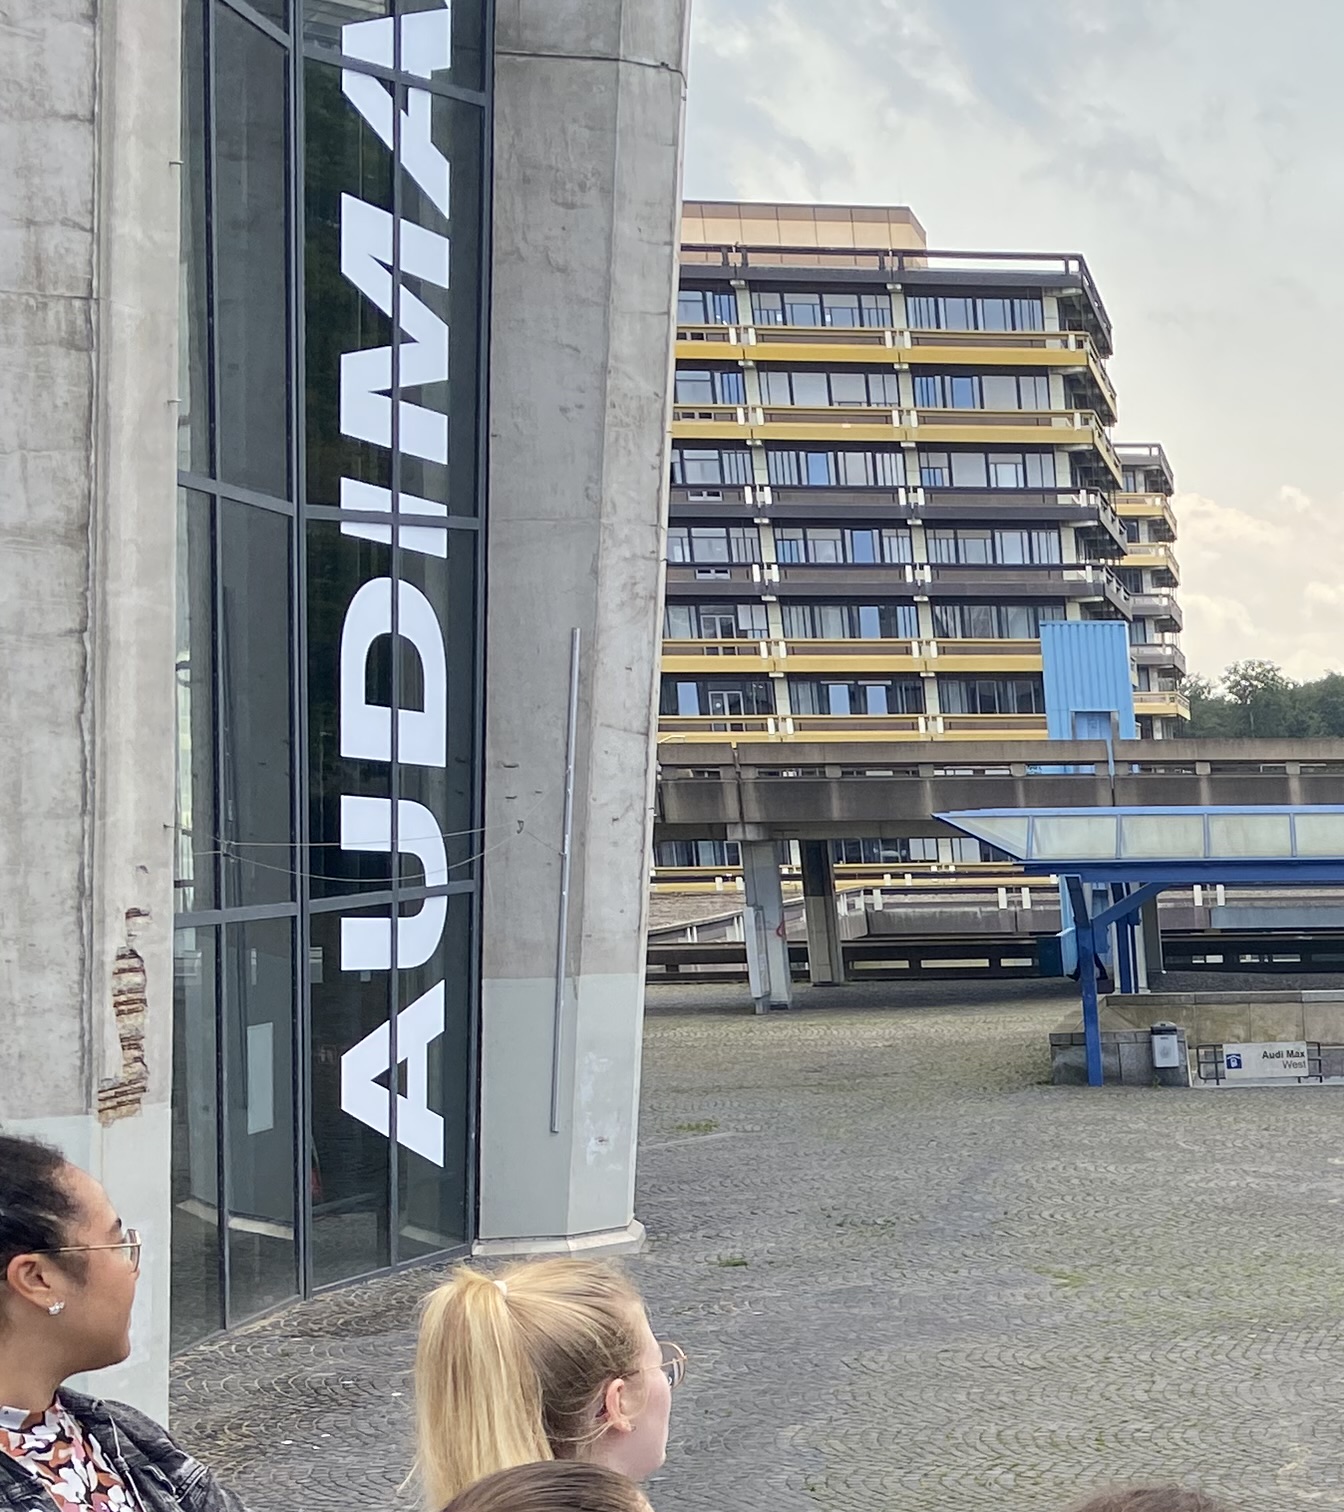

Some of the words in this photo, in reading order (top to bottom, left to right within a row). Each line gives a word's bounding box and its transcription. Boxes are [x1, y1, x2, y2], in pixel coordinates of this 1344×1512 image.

[340, 0, 452, 1168] AUDIMA
[1262, 1050, 1284, 1059] Audi
[1286, 1049, 1306, 1058] Max
[1282, 1060, 1307, 1069] West
